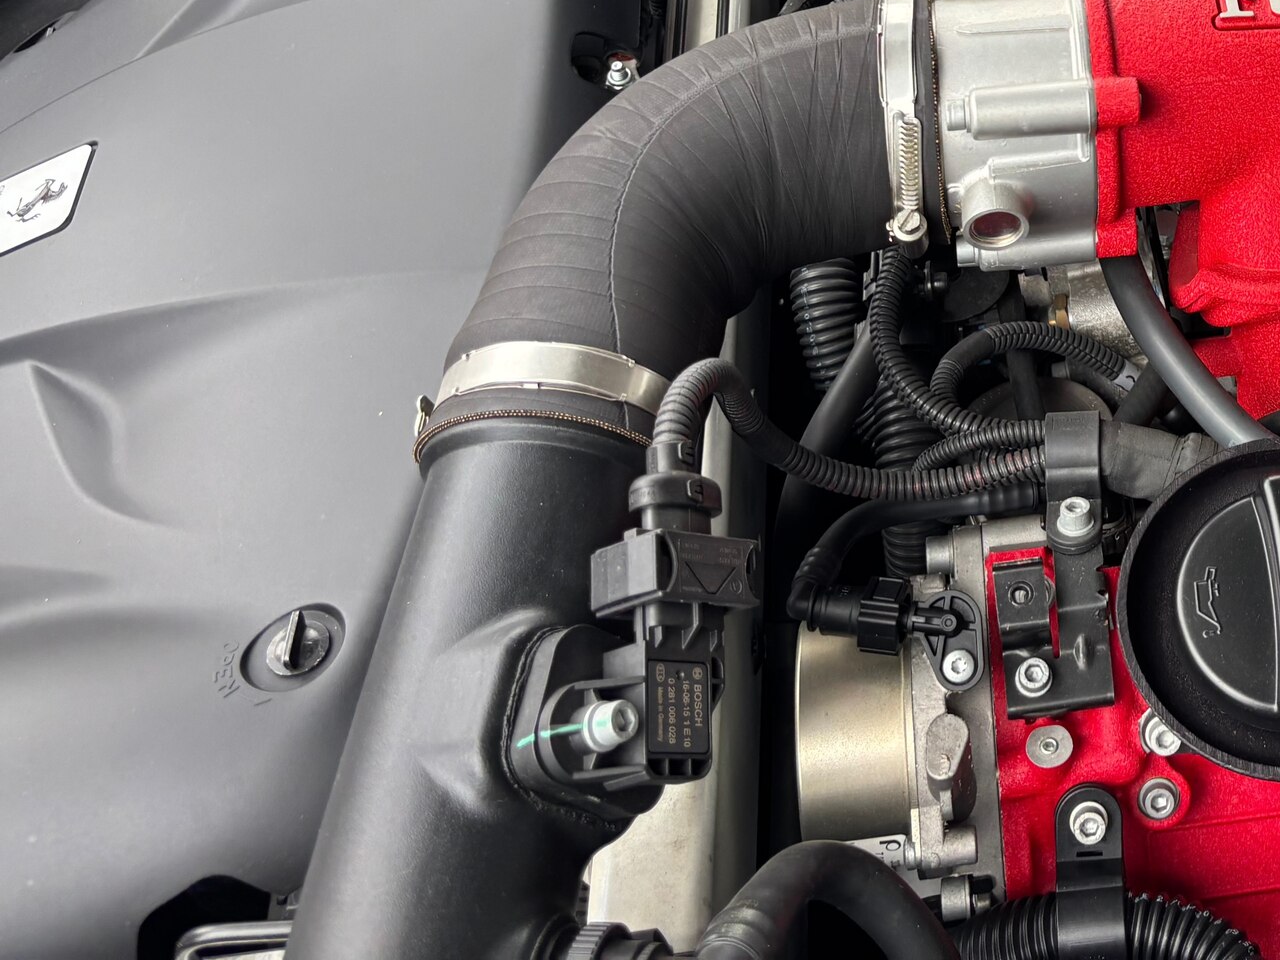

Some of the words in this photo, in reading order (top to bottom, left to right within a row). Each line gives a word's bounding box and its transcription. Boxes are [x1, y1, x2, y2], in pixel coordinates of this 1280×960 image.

[214, 640, 241, 699] OPEN
[668, 686, 676, 703] 281
[693, 684, 703, 727] BOSCH
[668, 706, 676, 724] 006
[668, 726, 677, 744] 028
